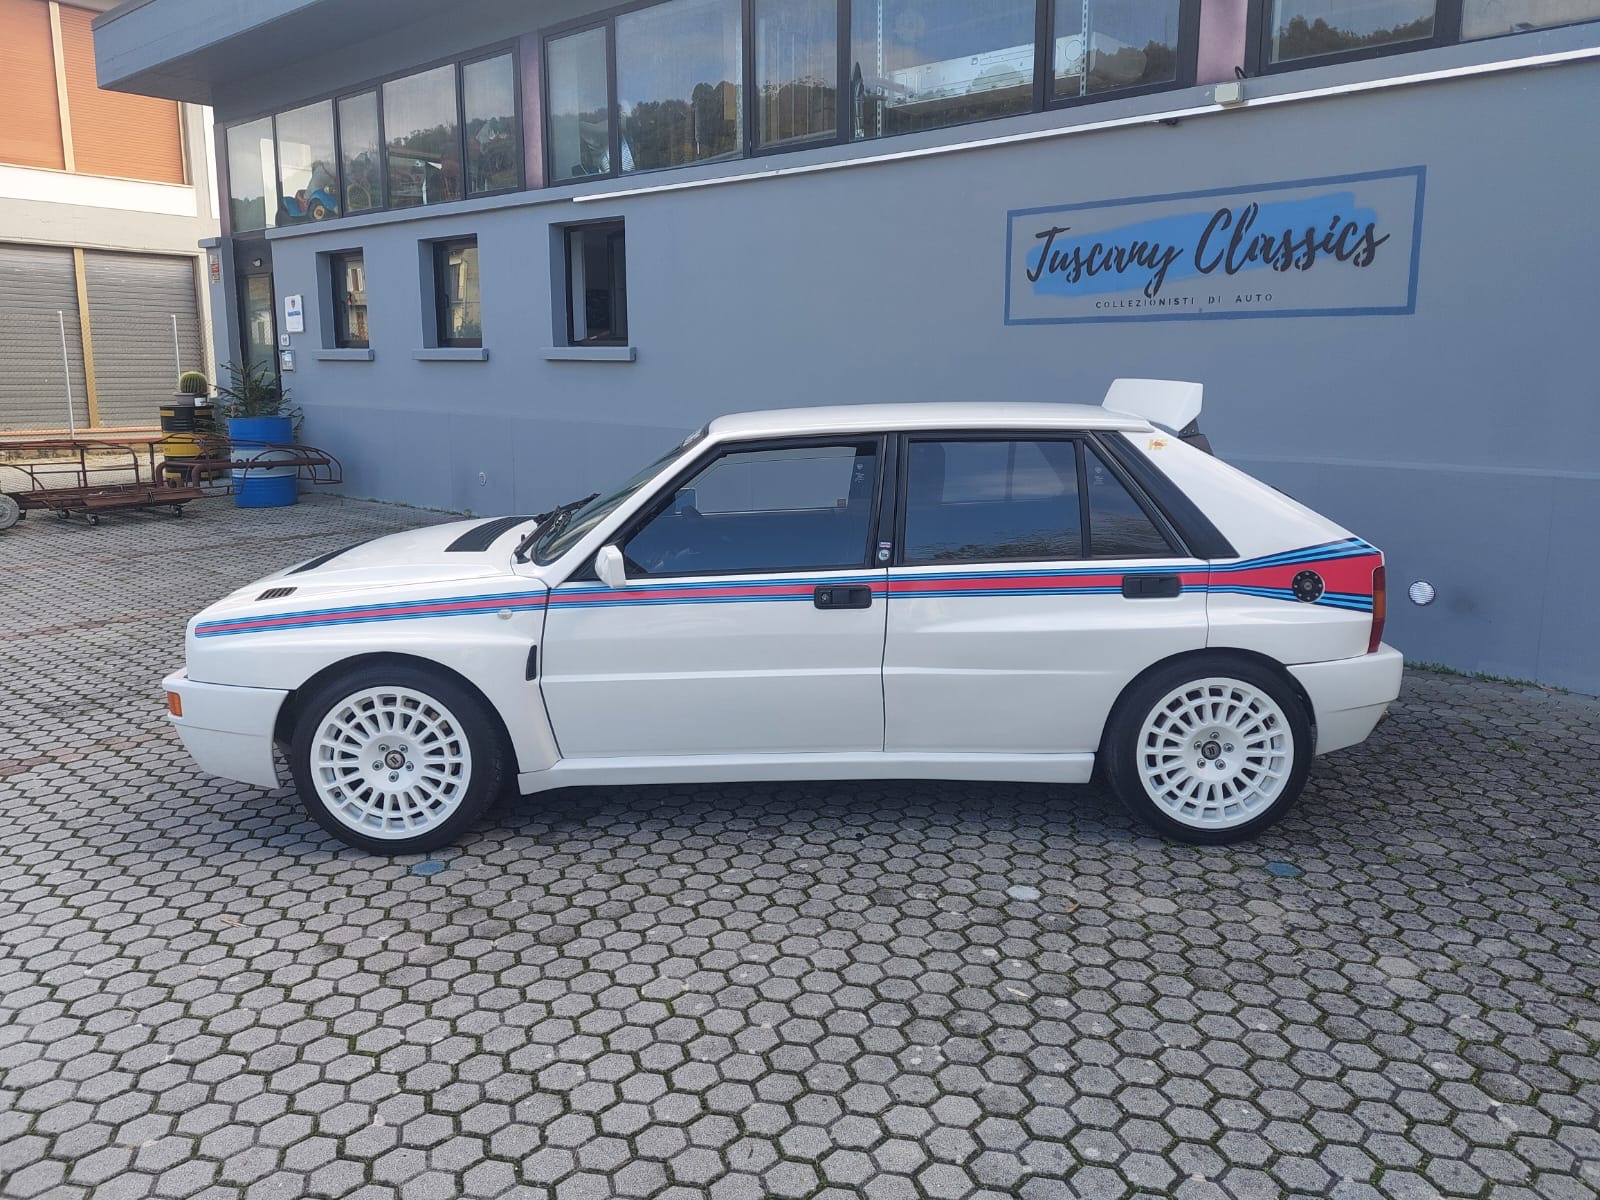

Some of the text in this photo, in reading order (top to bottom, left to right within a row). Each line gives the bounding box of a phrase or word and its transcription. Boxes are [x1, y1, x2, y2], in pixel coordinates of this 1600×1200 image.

[1026, 202, 1391, 298] Tuscany Classics
[1096, 293, 1274, 309] COLLEZIONISTI DI AUTO
